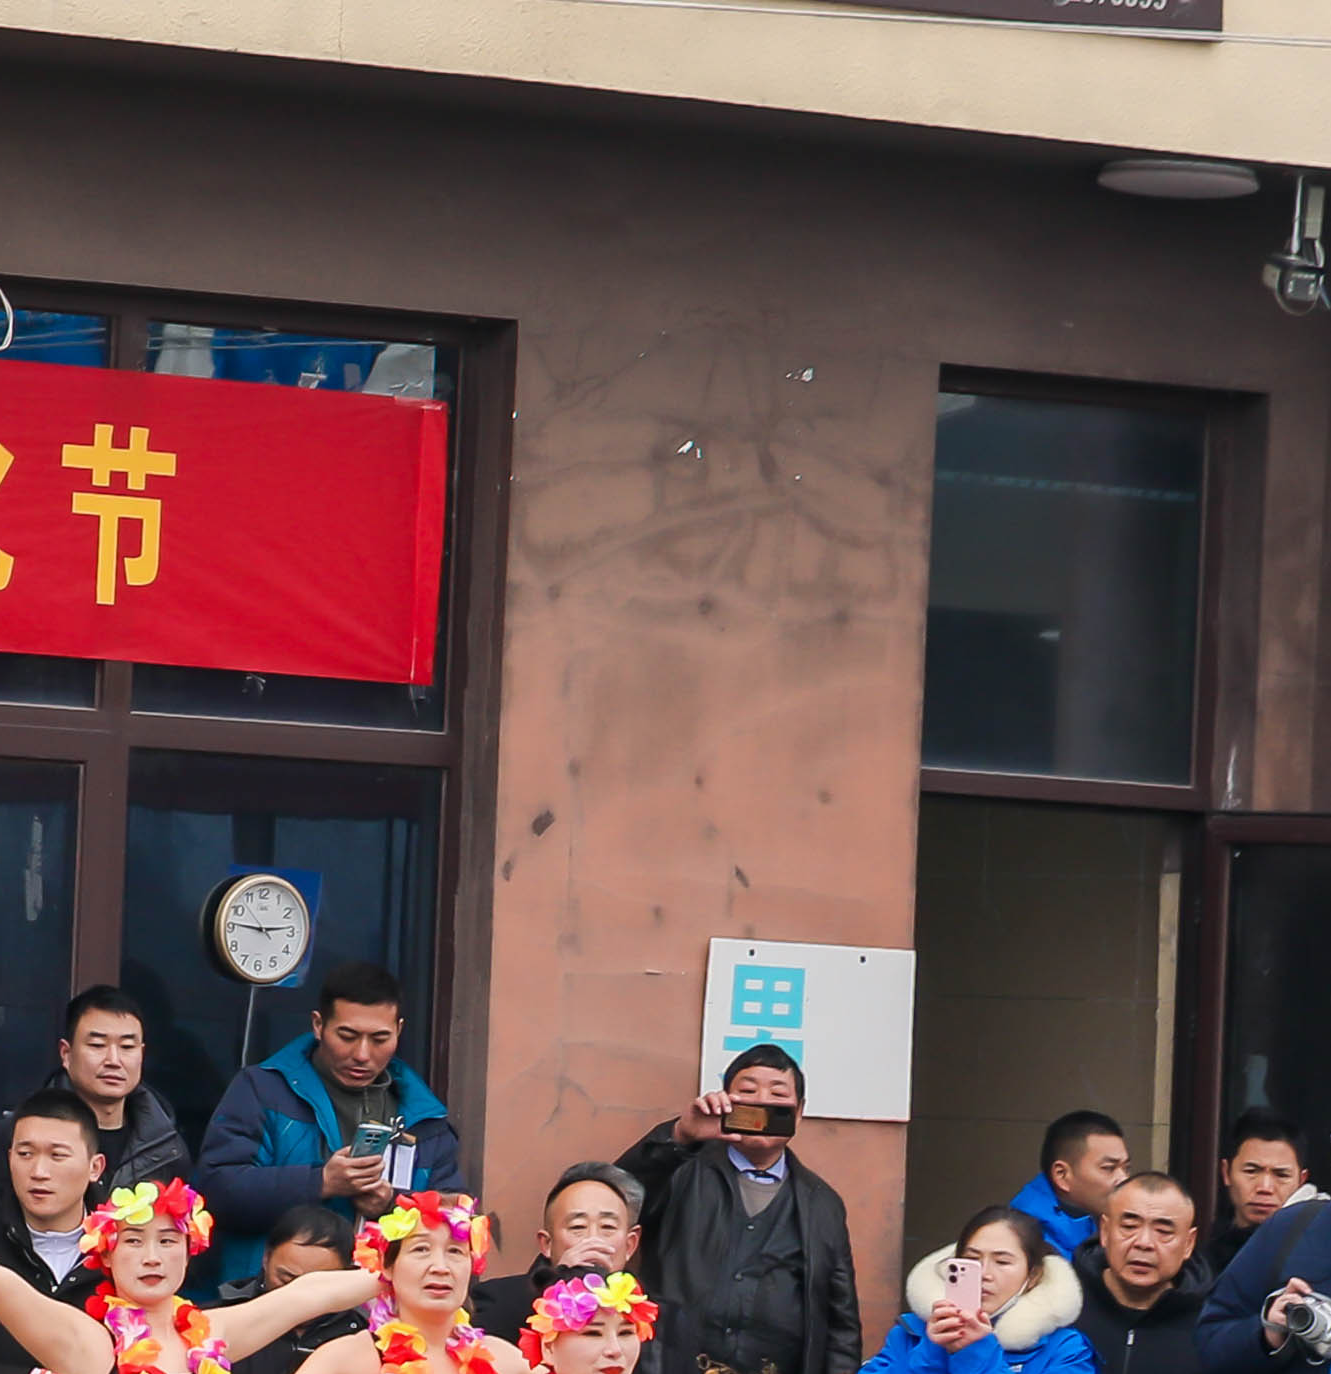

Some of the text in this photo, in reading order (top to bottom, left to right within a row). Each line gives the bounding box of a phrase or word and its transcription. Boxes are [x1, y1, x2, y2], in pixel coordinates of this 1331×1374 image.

[246, 892, 254, 902] 11
[258, 888, 269, 900] 12
[232, 905, 244, 916] 10
[283, 908, 292, 919] 2
[227, 922, 235, 933] 9
[286, 926, 294, 938] 3
[230, 940, 238, 952] 8
[282, 944, 291, 955] 4
[240, 954, 249, 966] 7
[254, 960, 262, 972] 6
[268, 956, 278, 968] 5
